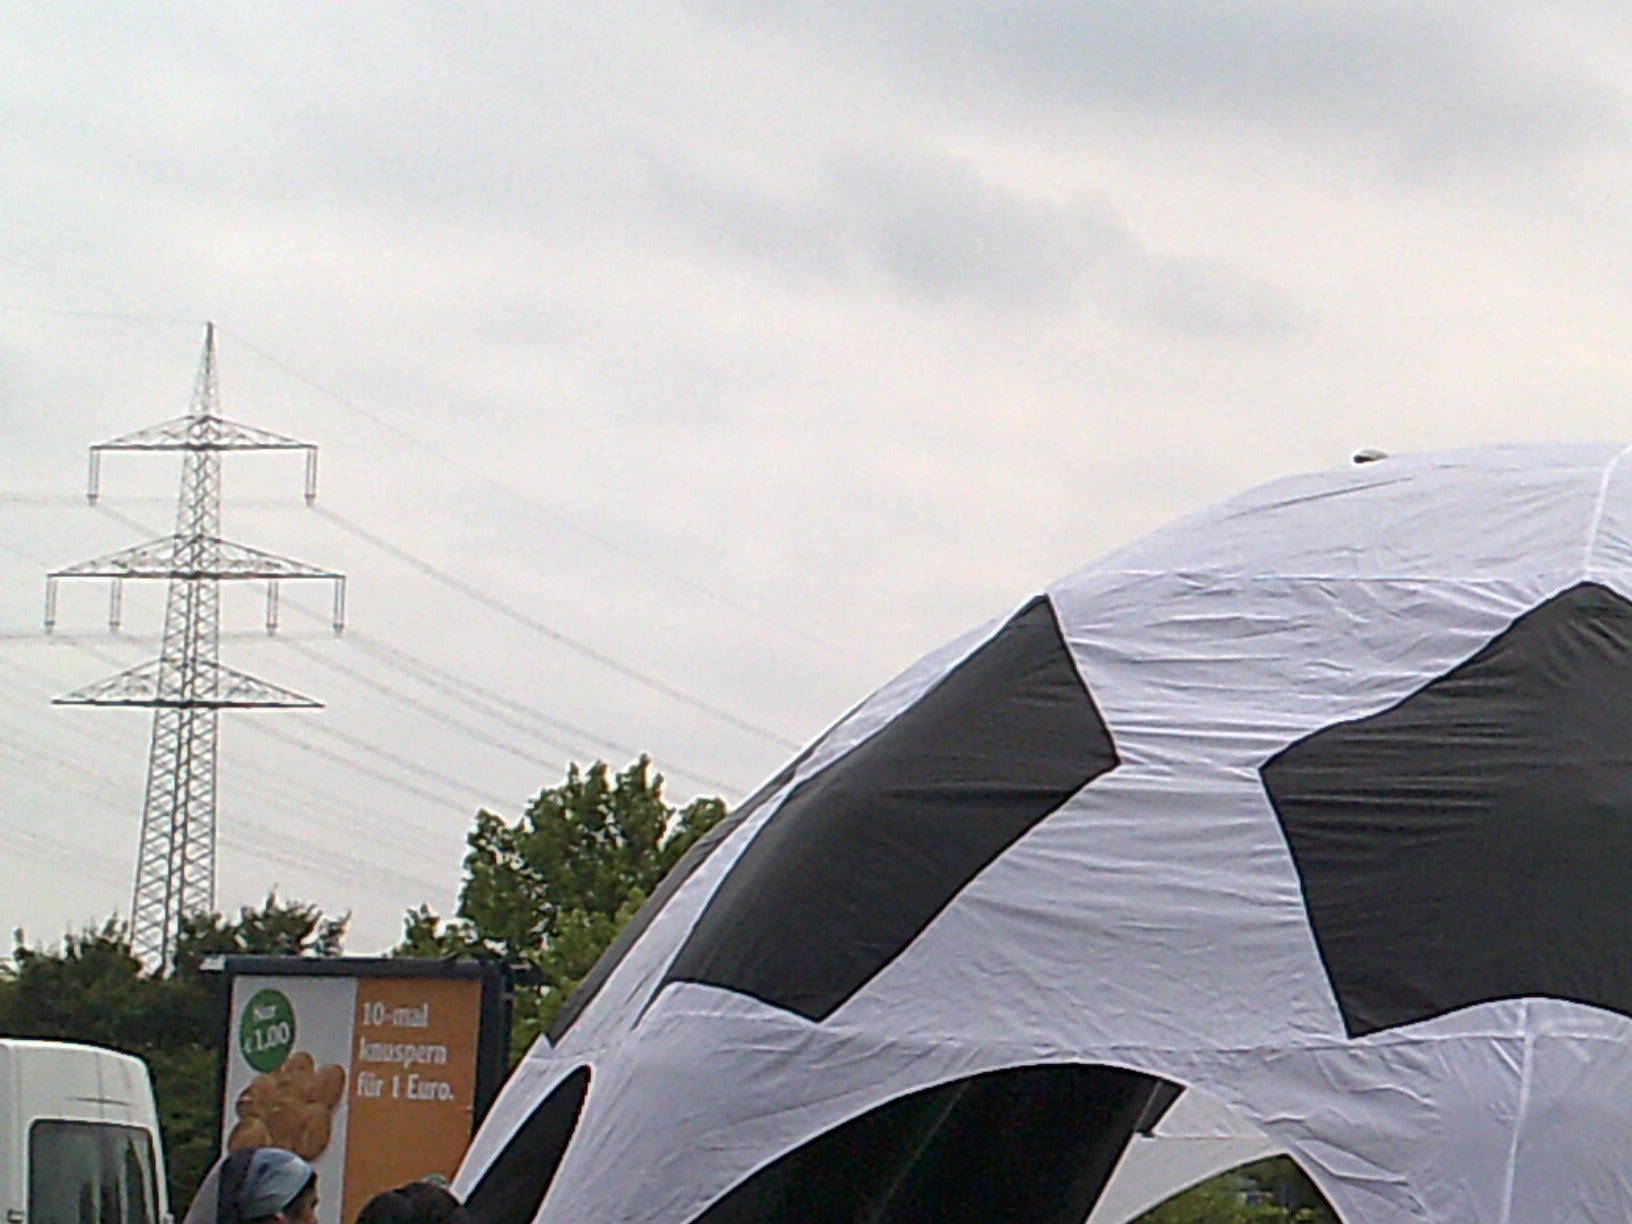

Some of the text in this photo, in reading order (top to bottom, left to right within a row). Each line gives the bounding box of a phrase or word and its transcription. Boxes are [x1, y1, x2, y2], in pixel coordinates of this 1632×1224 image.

[363, 1002, 428, 1028] 10-mal
[360, 1037, 447, 1068] knuspern
[357, 1071, 454, 1100] für 1 Euro.
